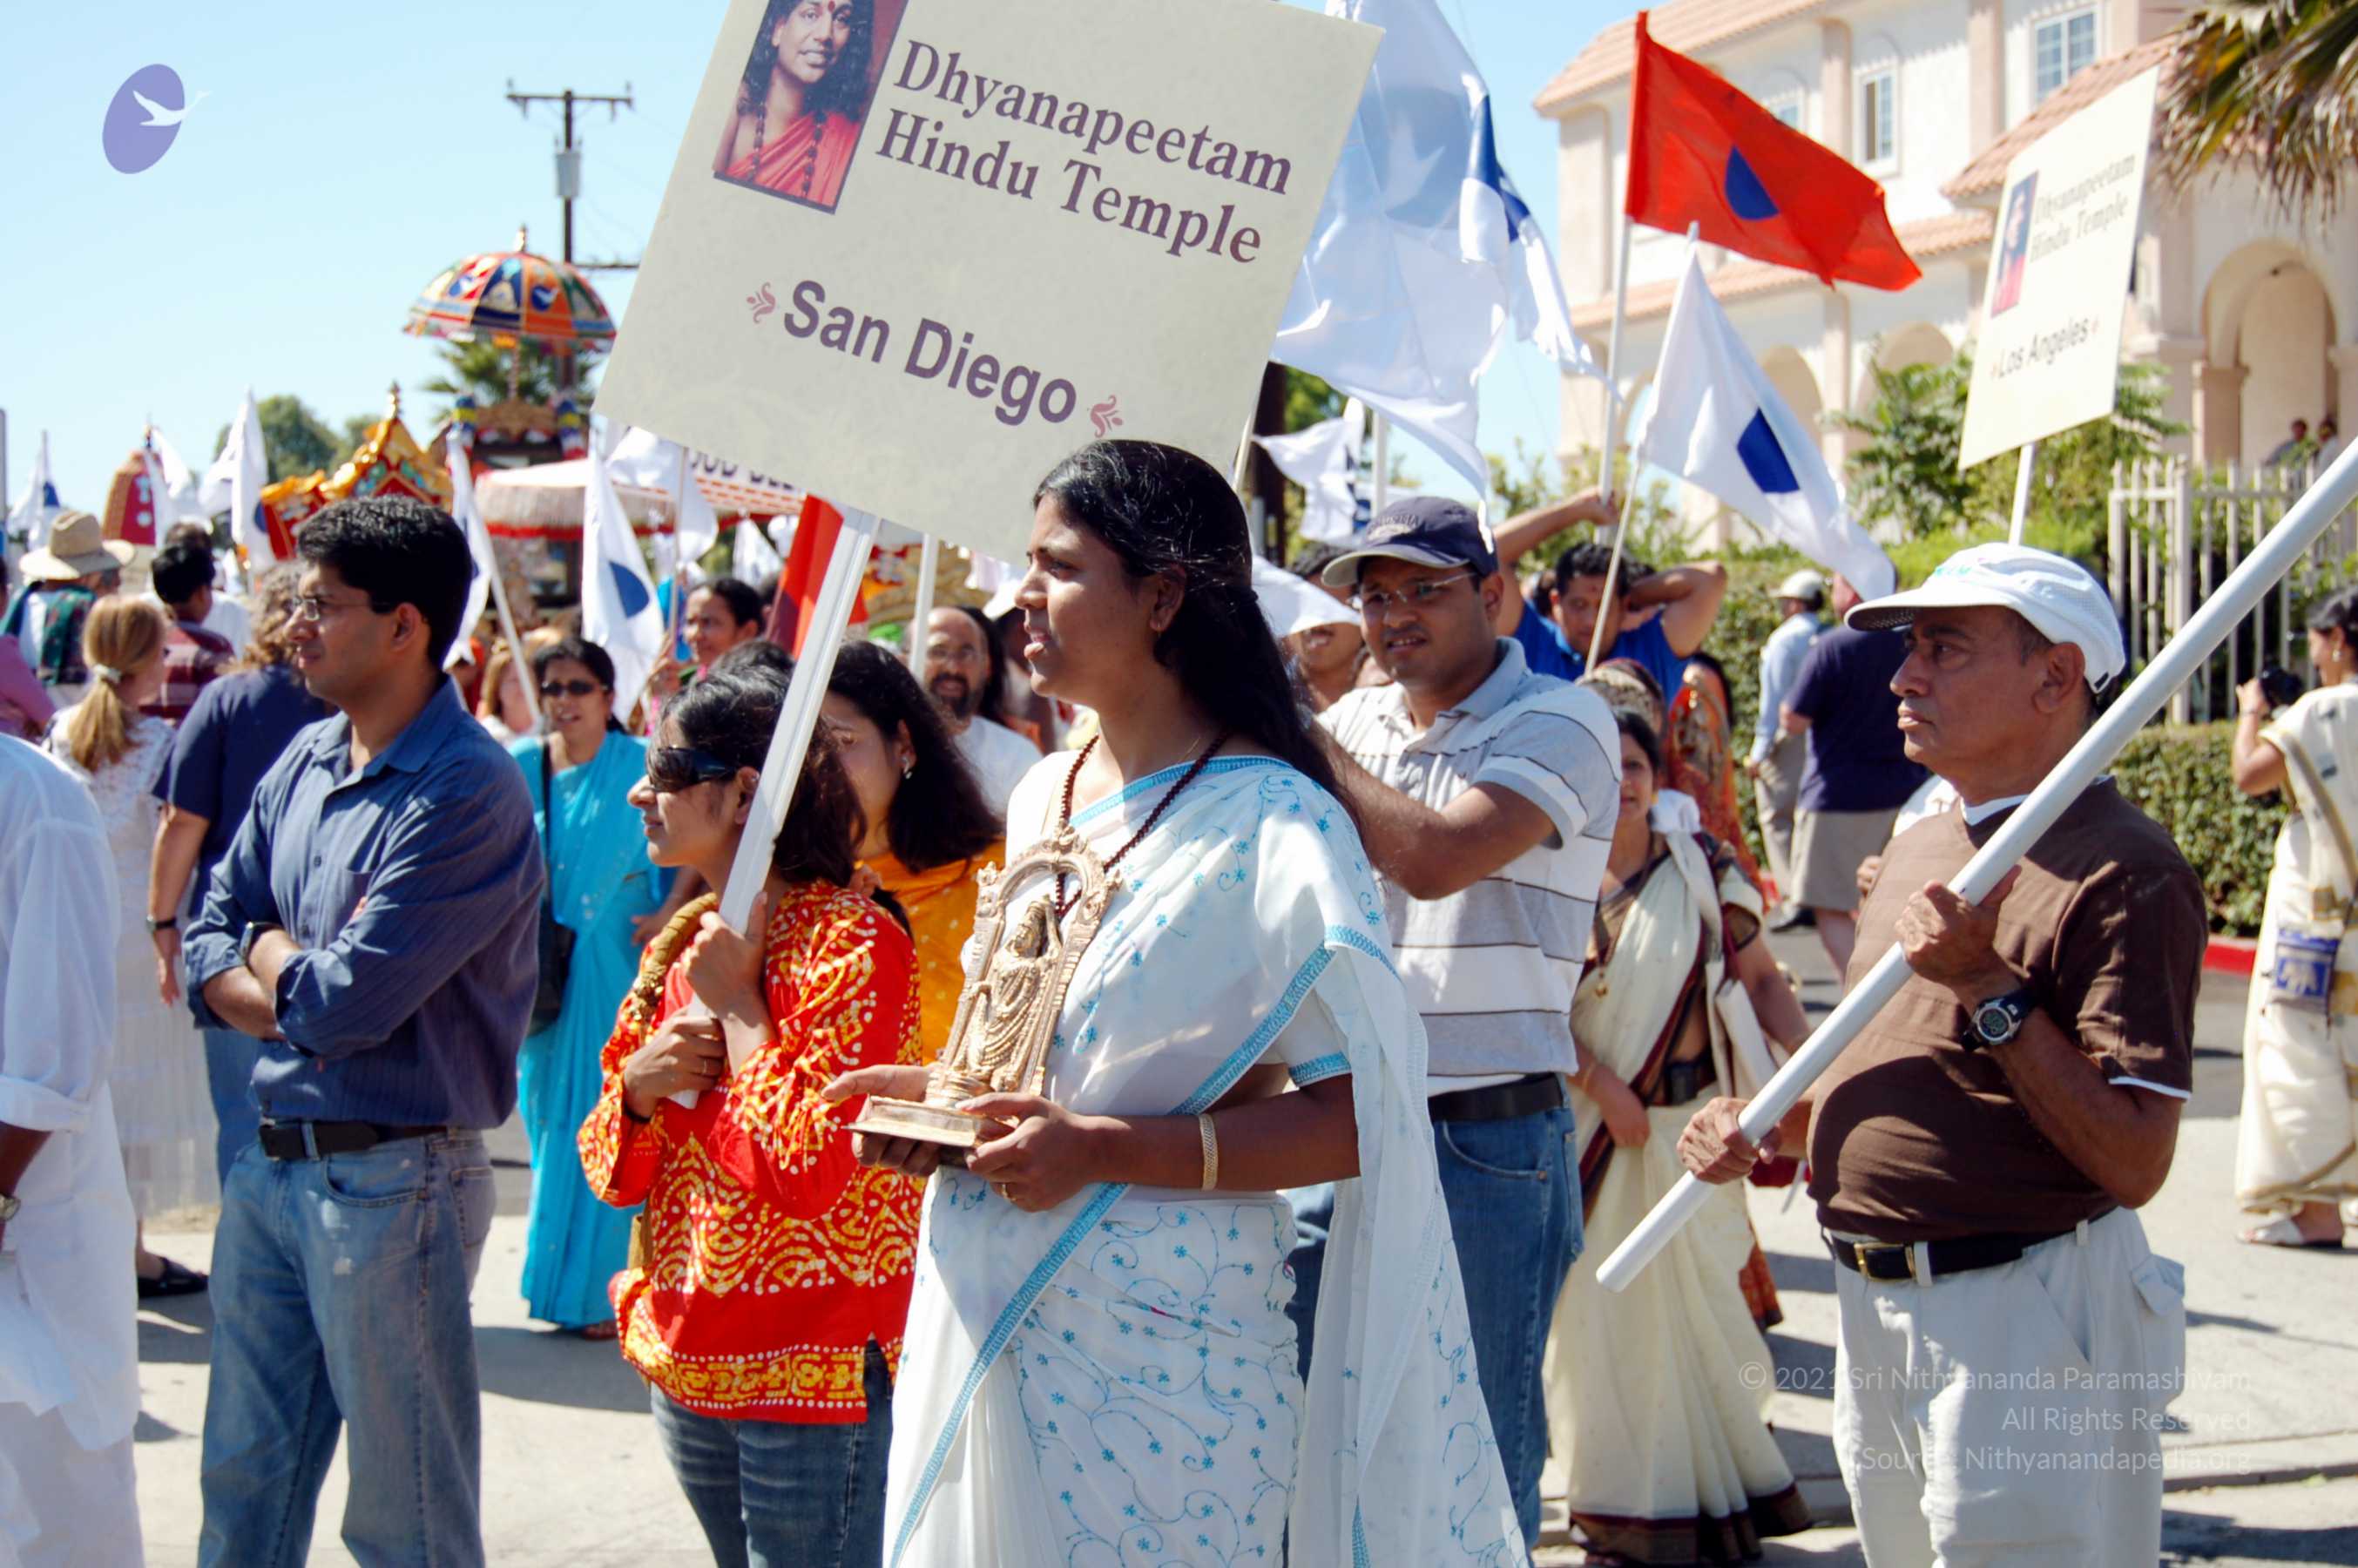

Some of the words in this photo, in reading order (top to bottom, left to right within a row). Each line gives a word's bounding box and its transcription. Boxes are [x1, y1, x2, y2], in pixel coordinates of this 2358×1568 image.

[875, 108, 1039, 200] Hindu
[1060, 159, 1261, 263] Temple
[894, 40, 1292, 196] Dhyanapeetam
[2077, 191, 2128, 240] Temple
[784, 280, 890, 364] San
[904, 317, 1078, 426] Diego
[1998, 346, 2024, 379] Los
[2027, 314, 2090, 366] Angeles
